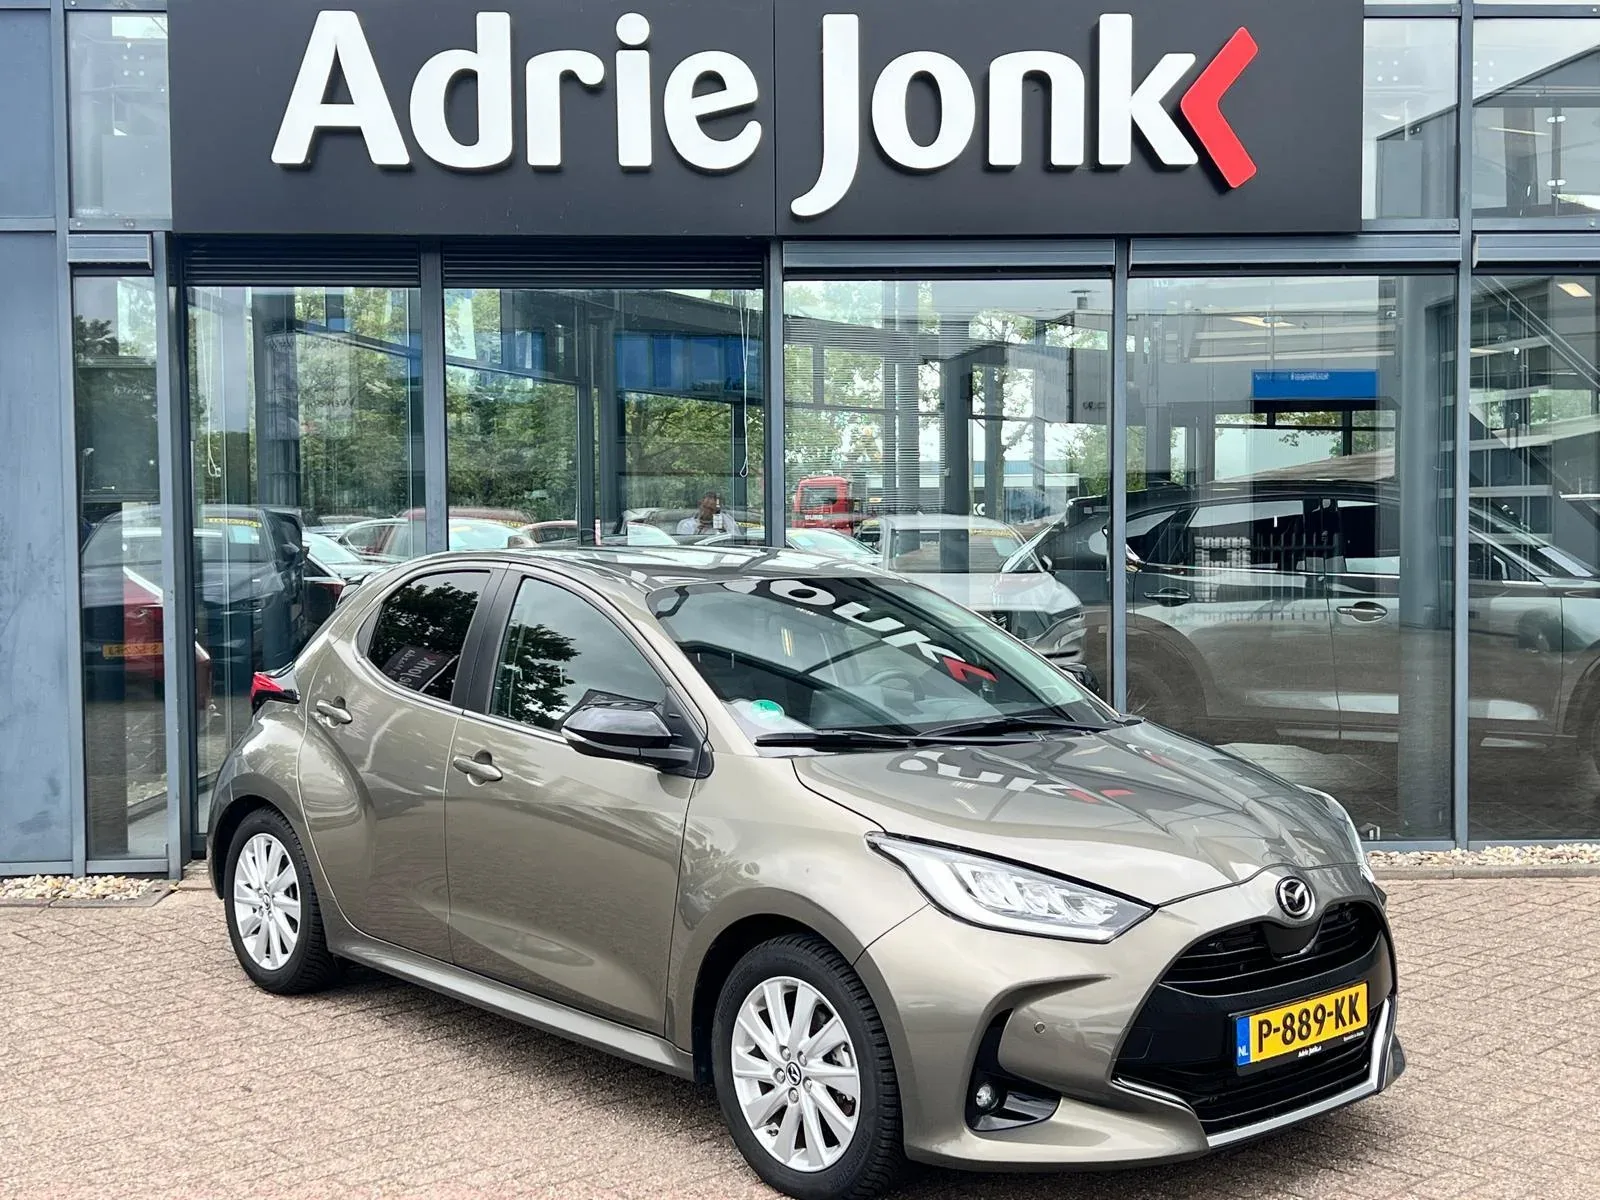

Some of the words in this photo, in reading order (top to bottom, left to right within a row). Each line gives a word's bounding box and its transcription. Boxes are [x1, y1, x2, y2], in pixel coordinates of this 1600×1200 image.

[271, 11, 762, 169] Adrie
[791, 13, 1199, 218] Jonk
[1237, 1046, 1249, 1057] NL
[1257, 991, 1361, 1054] P-889-KK
